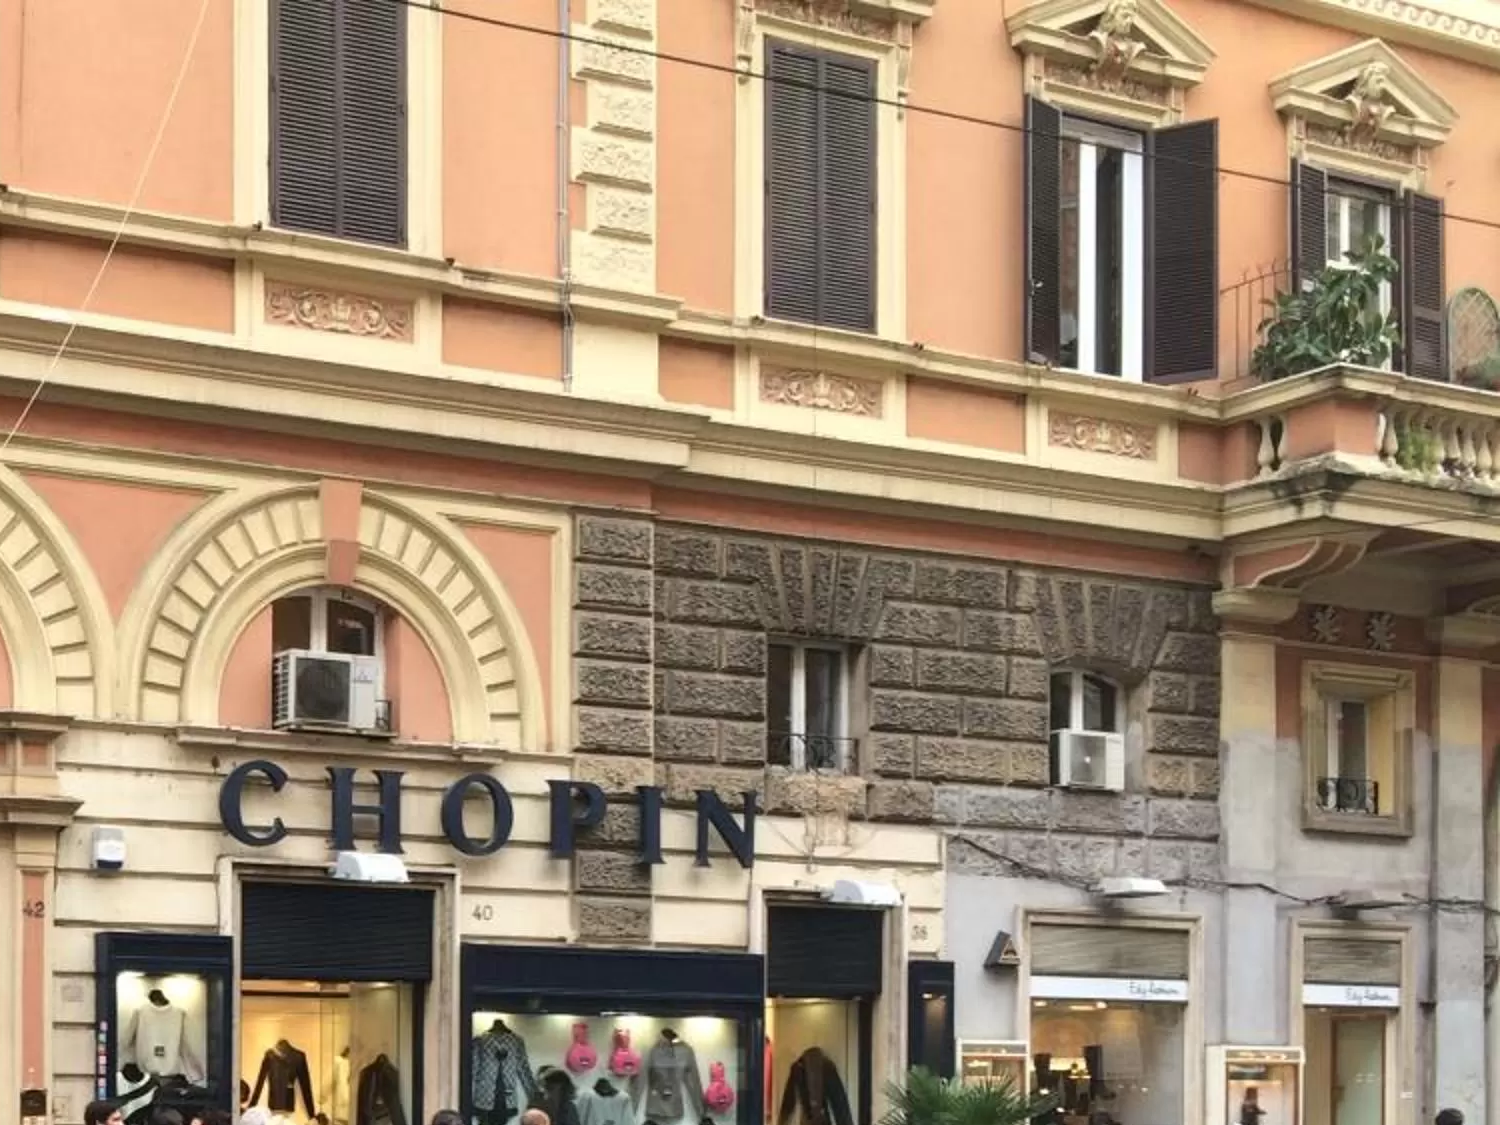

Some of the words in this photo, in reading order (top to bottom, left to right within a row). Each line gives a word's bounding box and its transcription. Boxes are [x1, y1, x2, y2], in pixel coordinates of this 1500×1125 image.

[218, 758, 759, 869] CHOPIN
[22, 900, 45, 919] 42
[471, 904, 493, 921] 40
